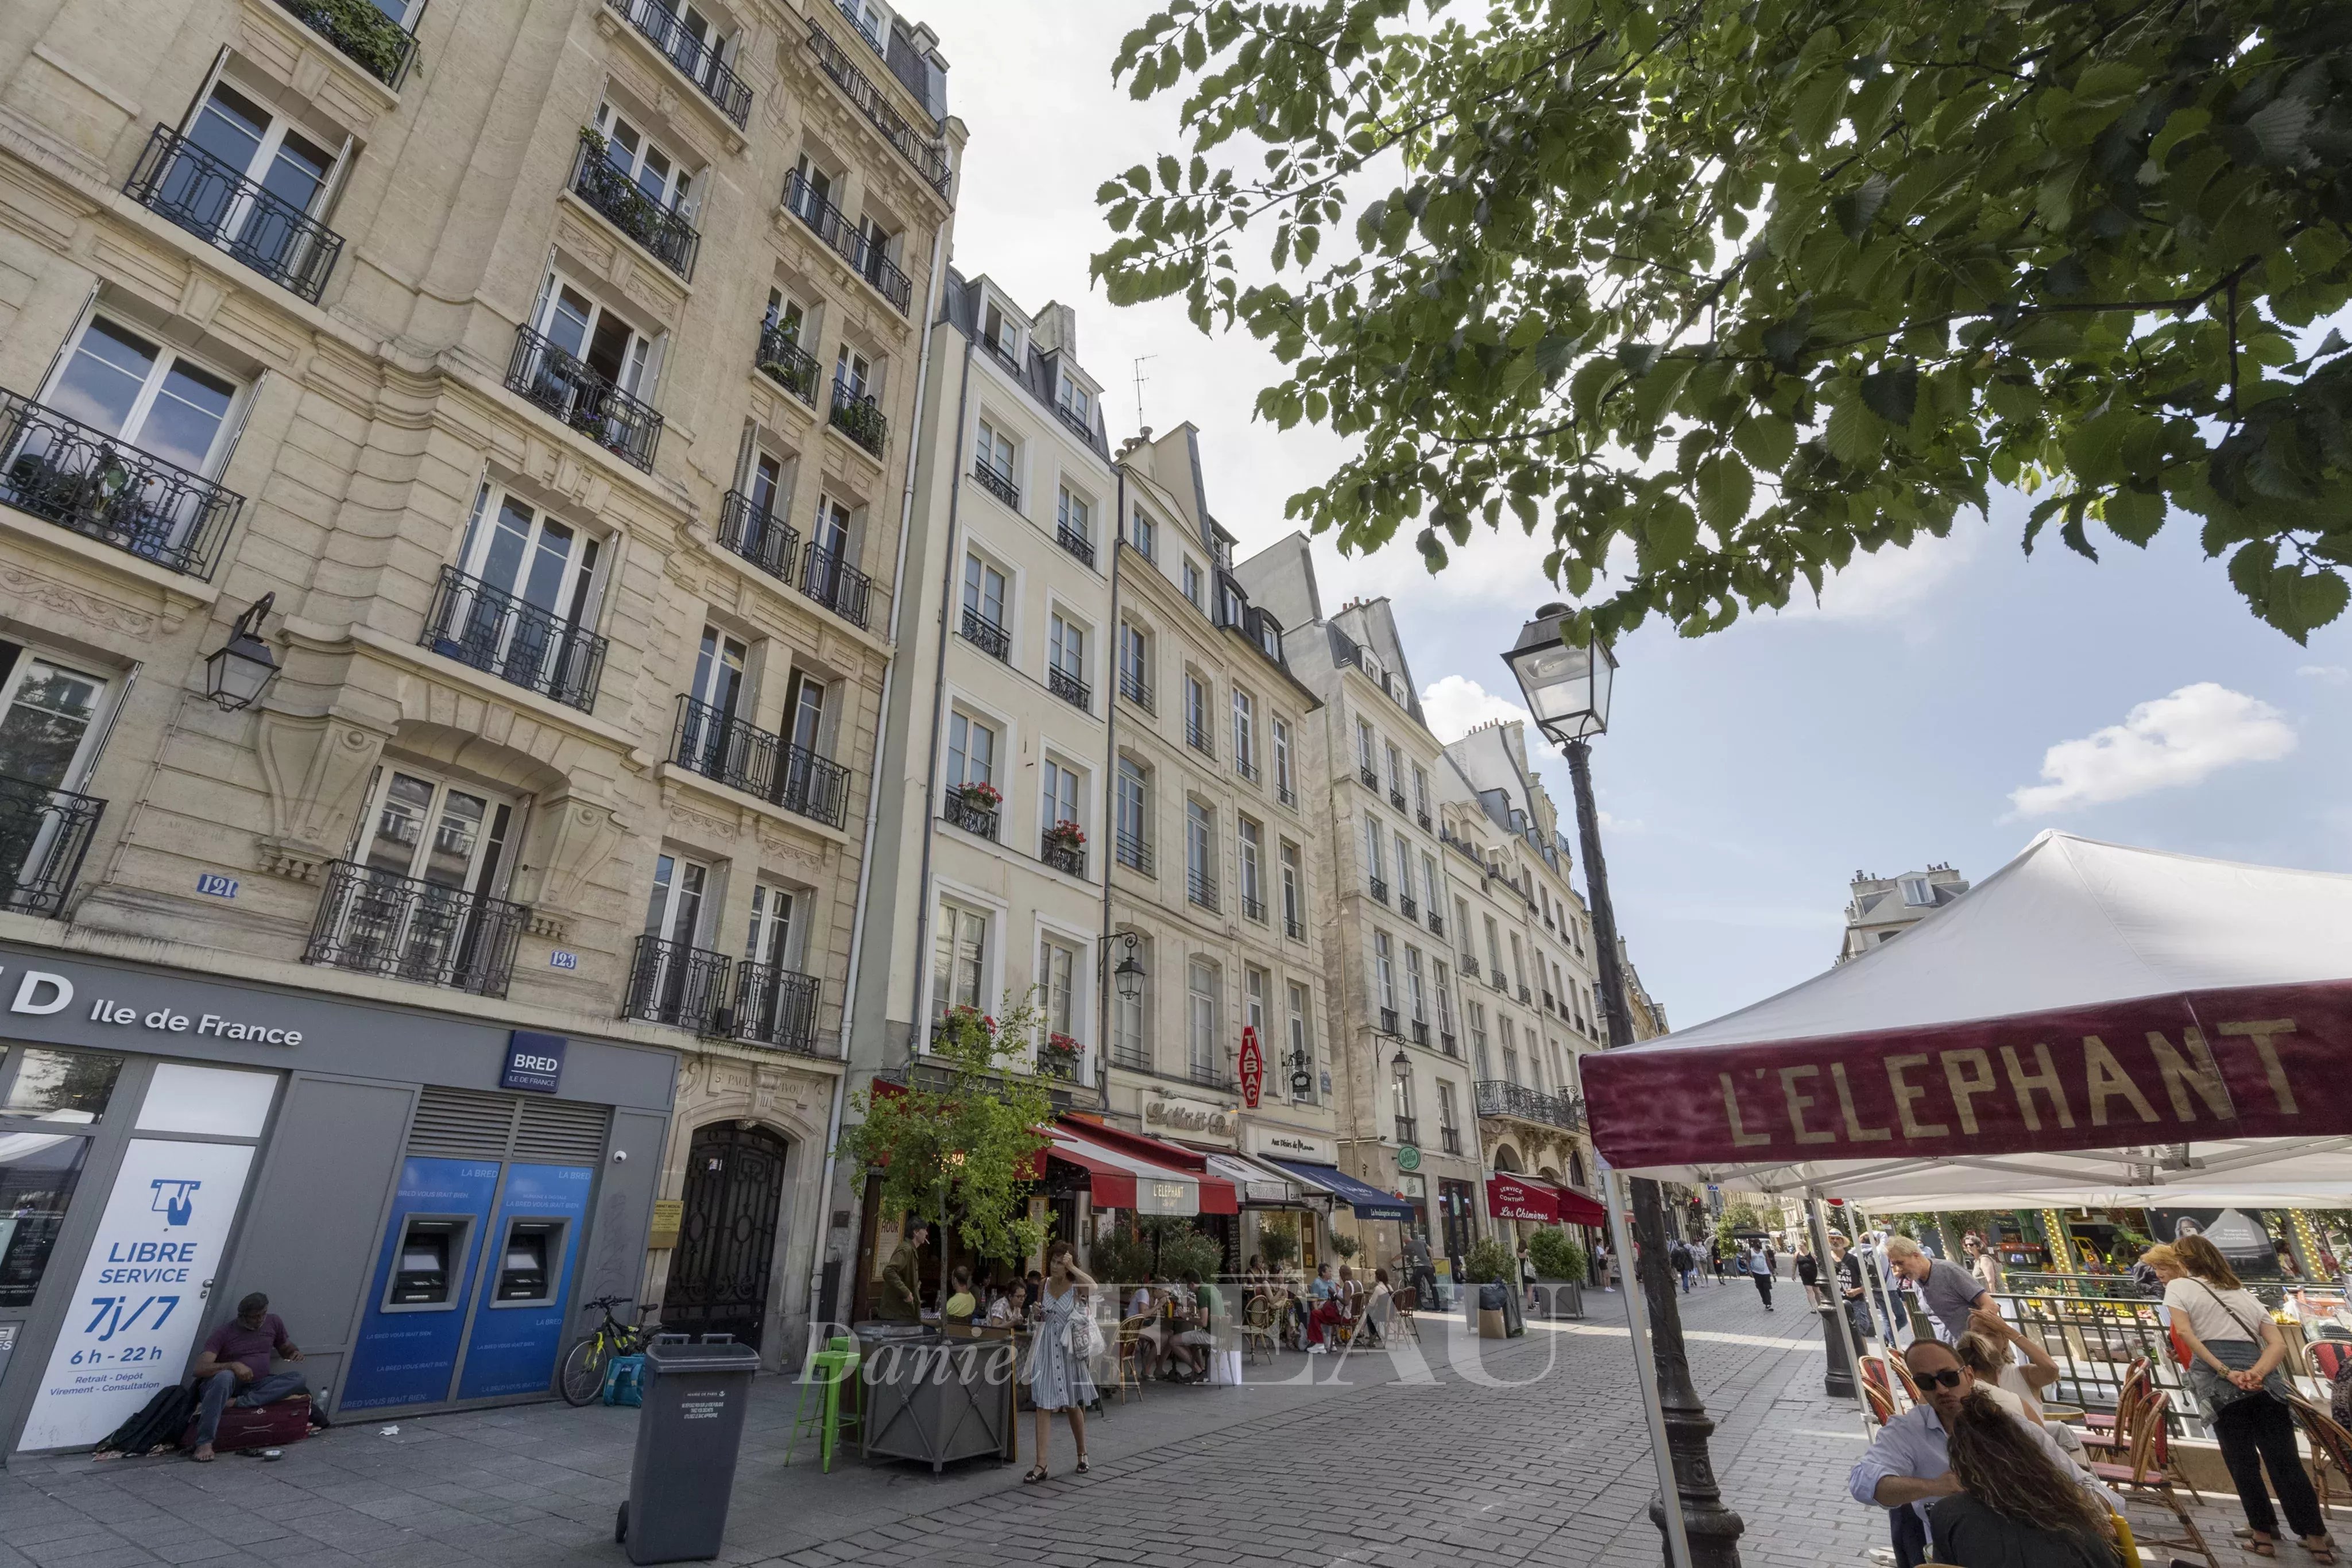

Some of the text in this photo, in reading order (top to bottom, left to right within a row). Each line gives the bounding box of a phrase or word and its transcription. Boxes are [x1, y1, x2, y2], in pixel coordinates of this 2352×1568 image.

[201, 875, 235, 896] 121
[552, 951, 575, 968] 123
[90, 999, 136, 1024] Ile
[145, 1008, 189, 1031] de
[197, 1014, 303, 1046] France
[513, 1054, 558, 1071] BRED
[1243, 1035, 1258, 1100] TABAC
[529, 1078, 555, 1086] FRANCE
[1718, 1018, 2300, 1148] L'ELEPHANT
[1271, 1138, 1279, 1146] Aux
[474, 1169, 498, 1178] BRED
[570, 1172, 590, 1180] BRED
[1154, 1184, 1183, 1198] L'ELEPHANT
[1250, 1186, 1268, 1199] SAINT
[1500, 1186, 1523, 1194] SERVICE
[1499, 1194, 1525, 1202] CONTINU
[1500, 1206, 1549, 1220] Les Chimères
[881, 1221, 899, 1233] HOUR
[108, 1242, 198, 1263] LIBRE
[98, 1268, 189, 1284] SERVICE
[84, 1296, 180, 1342] 7j/7
[70, 1350, 83, 1365] 6
[88, 1349, 101, 1364] h
[120, 1347, 146, 1362] 22
[149, 1346, 162, 1360] h
[75, 1375, 107, 1384] Retrait
[115, 1373, 143, 1382] Dépôt
[51, 1385, 94, 1395] Virement
[102, 1382, 160, 1392] Consultation
[341, 1400, 362, 1408] BRED
[365, 1397, 386, 1406] VOUS
[387, 1396, 407, 1404] IRAIT
